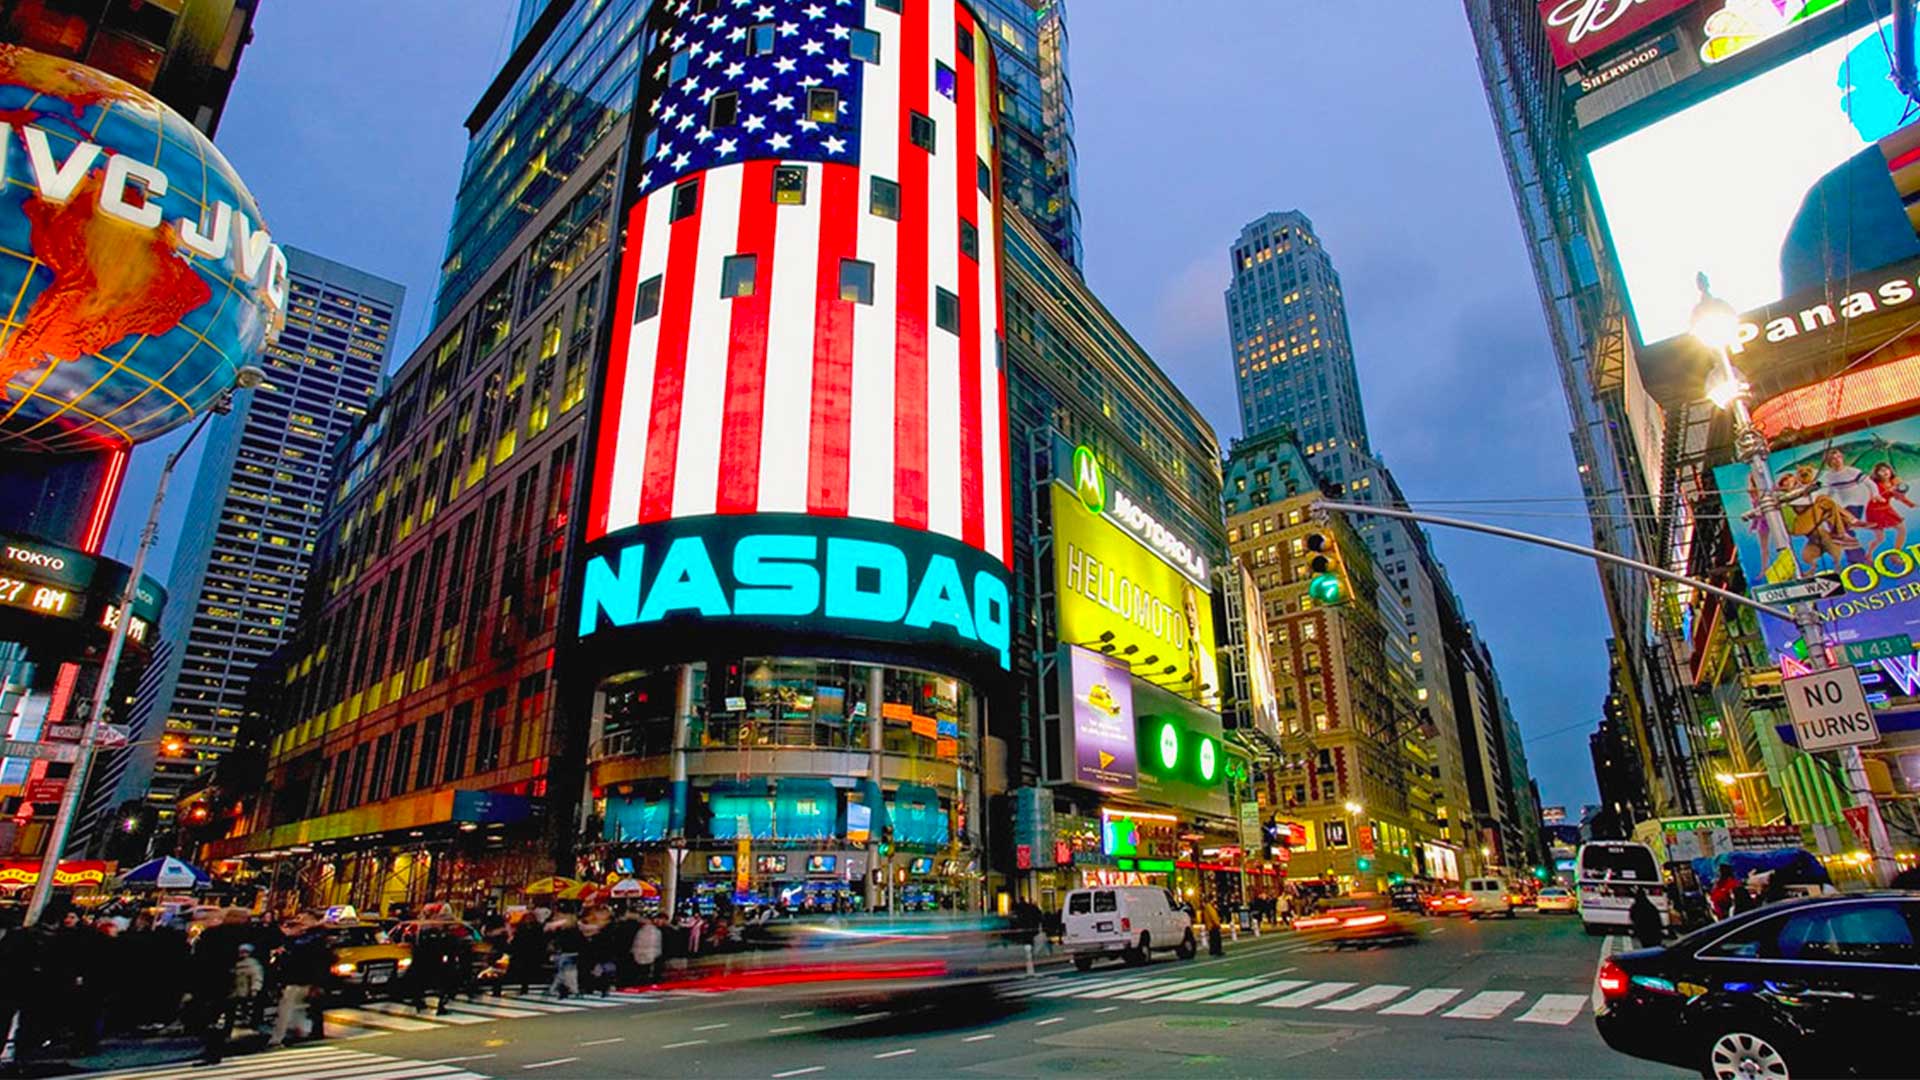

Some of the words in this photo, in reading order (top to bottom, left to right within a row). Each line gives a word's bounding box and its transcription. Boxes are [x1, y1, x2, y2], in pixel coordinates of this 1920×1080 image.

[1581, 48, 1658, 92] SHERWOOD
[176, 200, 288, 310] JVC
[1727, 273, 1920, 355] Panas
[1114, 490, 1206, 580] MOTOROLA
[7, 546, 65, 570] TOKYO
[32, 587, 67, 612] AM
[579, 534, 1011, 671] NASDAQ
[1067, 544, 1184, 649] HELLOMOTO
[1764, 589, 1790, 601] ONE
[1805, 581, 1833, 594] WAY
[1850, 645, 1864, 659] W
[1869, 641, 1893, 656] 43
[1803, 680, 1843, 708] NO
[1801, 712, 1871, 740] TURNS
